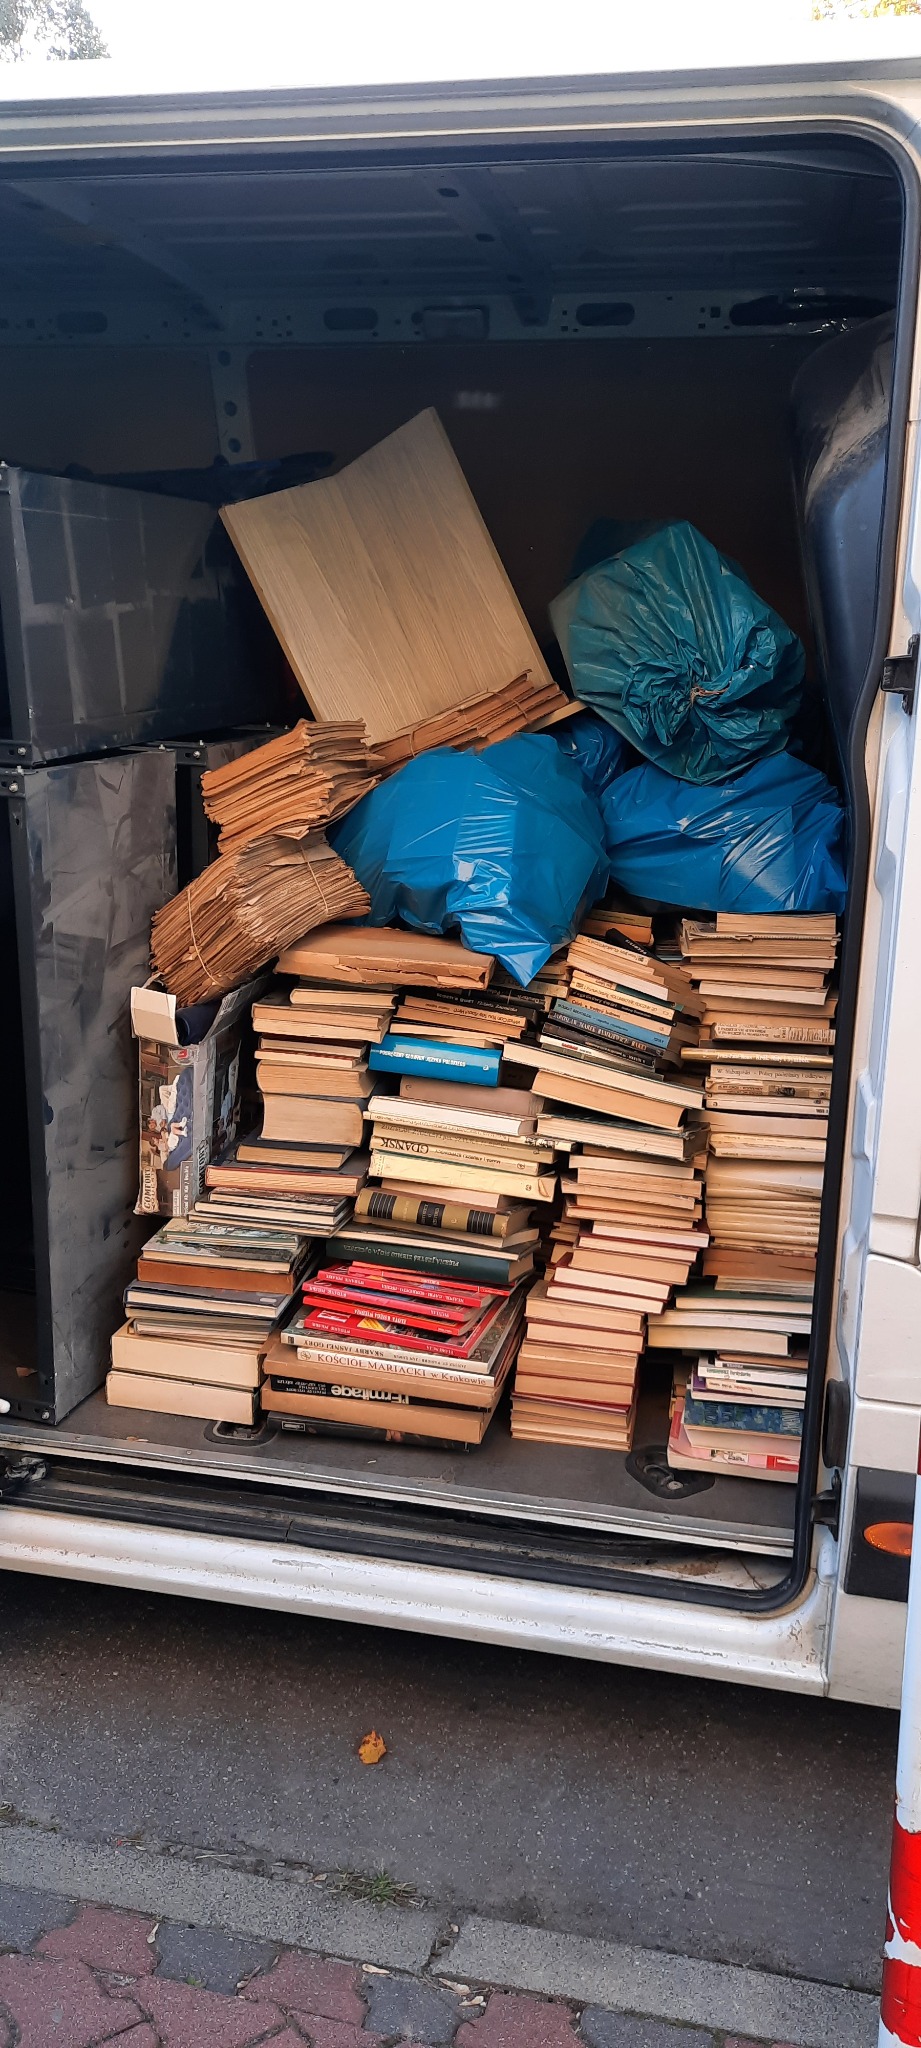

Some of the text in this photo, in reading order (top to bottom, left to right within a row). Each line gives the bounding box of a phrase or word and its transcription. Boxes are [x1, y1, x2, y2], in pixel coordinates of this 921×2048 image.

[326, 1343, 353, 1353] JASNEJ
[354, 1347, 384, 1357] SKARBY
[364, 1361, 426, 1377] MARIACKI
[440, 1371, 487, 1385] Krakowie
